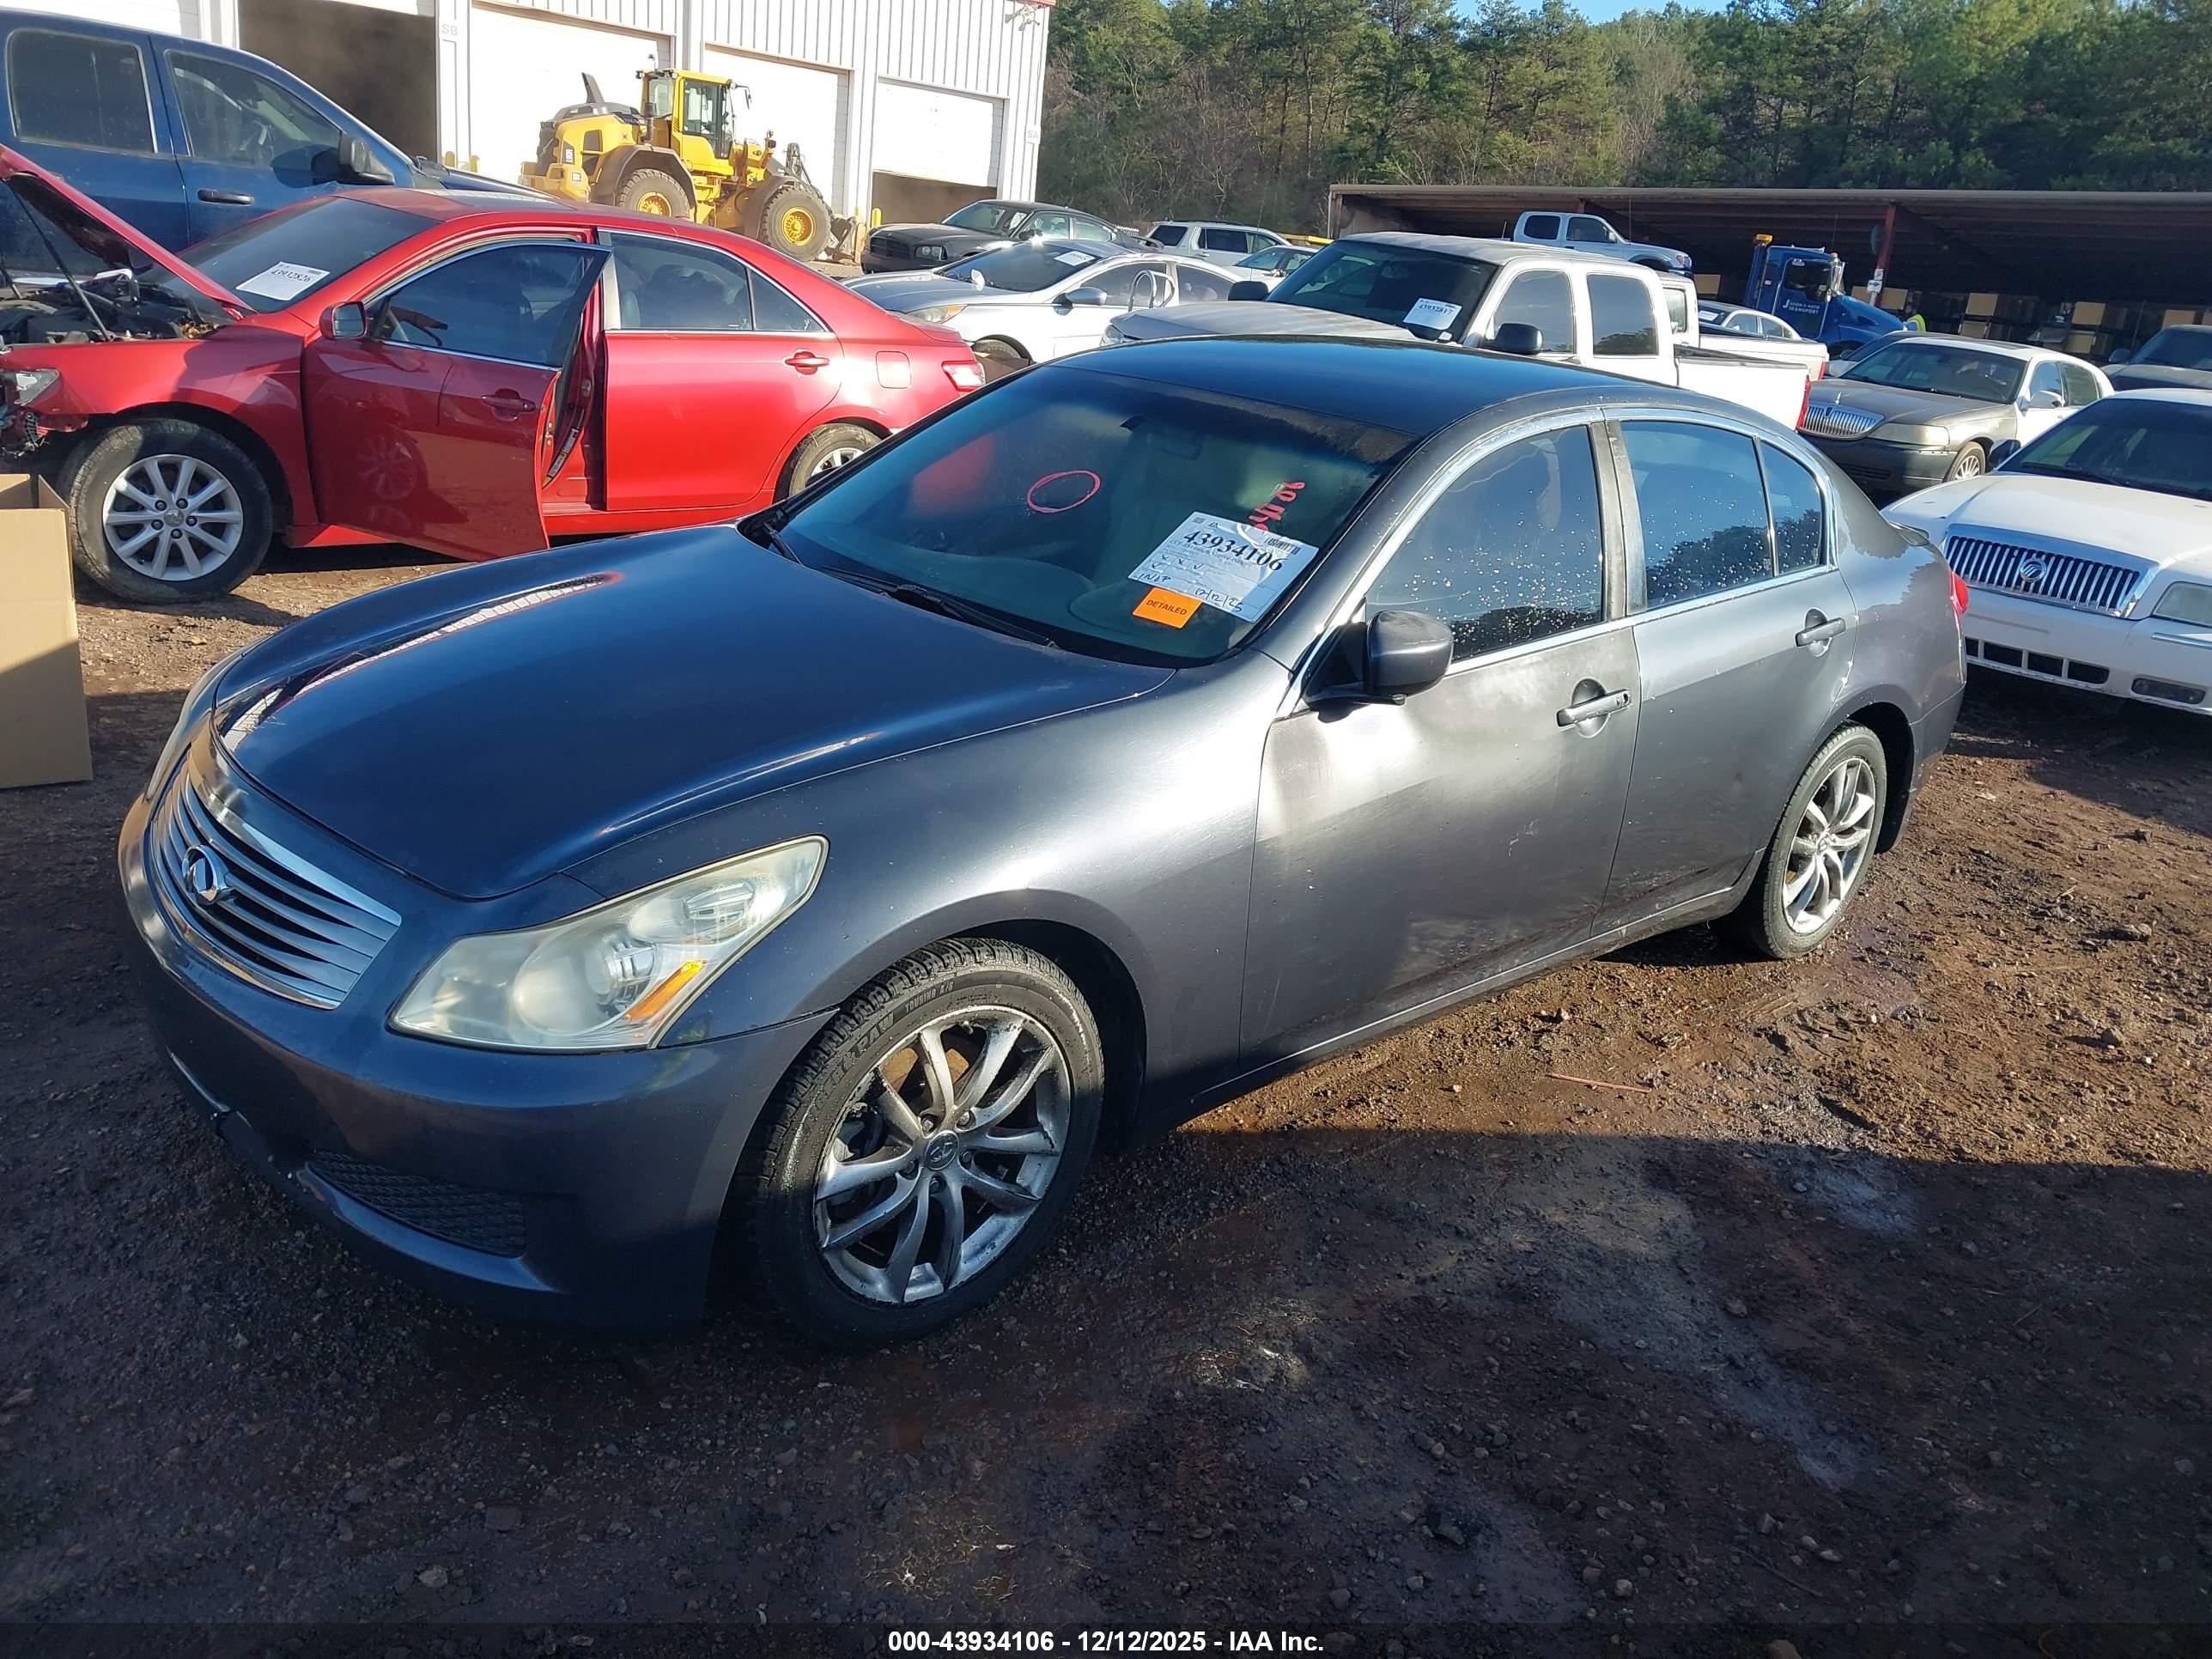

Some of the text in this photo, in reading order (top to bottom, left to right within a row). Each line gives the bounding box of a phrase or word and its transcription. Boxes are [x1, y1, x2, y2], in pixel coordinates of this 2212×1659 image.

[1183, 531, 1289, 571] 43934106
[1146, 599, 1187, 616] DETAILED
[1194, 588, 1244, 612] 12/12/25
[904, 989, 936, 1012] TOURING
